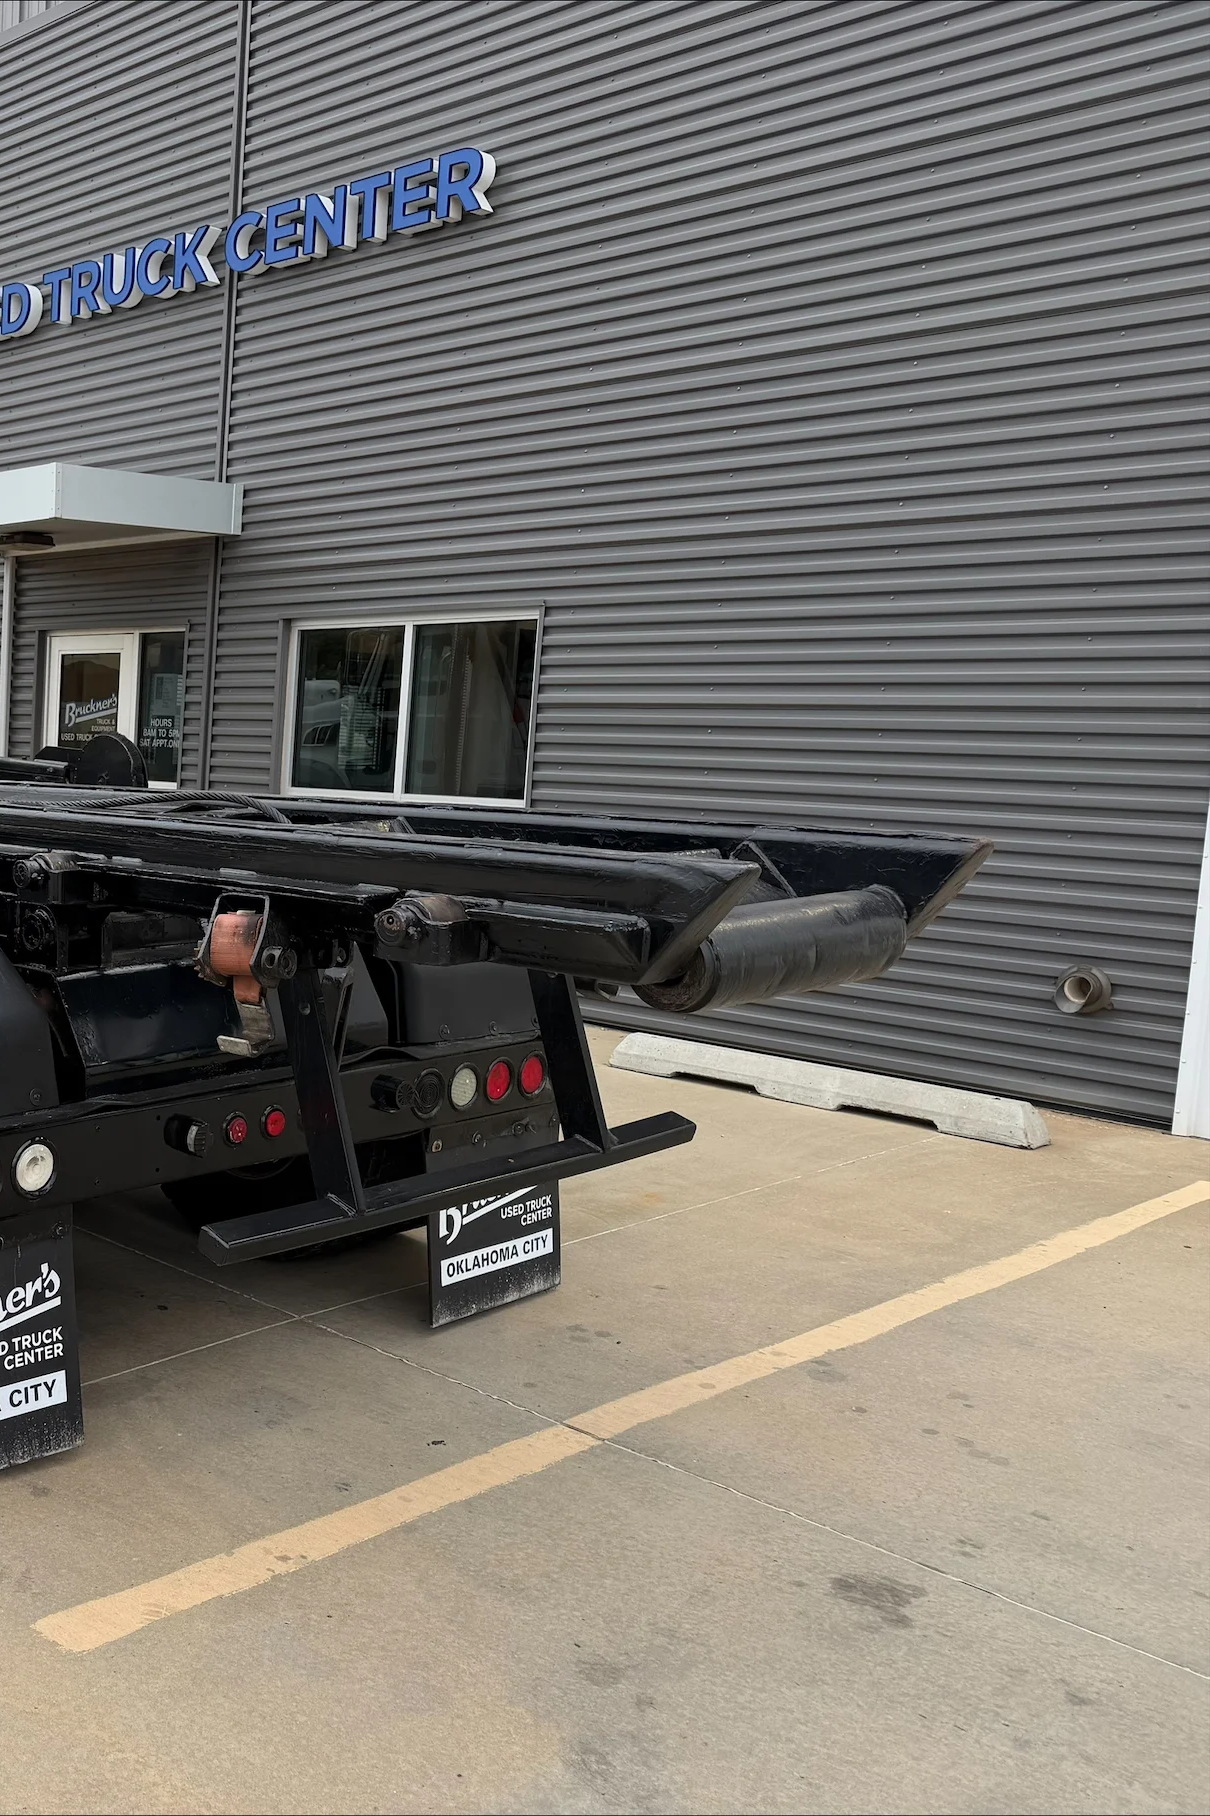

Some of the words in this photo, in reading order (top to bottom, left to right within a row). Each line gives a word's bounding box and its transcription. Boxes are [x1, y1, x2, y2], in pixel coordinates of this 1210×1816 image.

[43, 225, 218, 323] TRUCK
[224, 147, 492, 275] CENTER
[65, 693, 117, 727] Bruckner's
[150, 718, 172, 727] HOURS
[60, 733, 75, 741] USED
[139, 738, 151, 747] SAT
[142, 728, 157, 737] 8AM
[158, 729, 167, 738] TO
[500, 1203, 524, 1219] USED
[525, 1194, 552, 1213] TRUCK
[520, 1207, 552, 1226] CENTER
[446, 1244, 519, 1278] OKLAHOMA
[522, 1234, 548, 1255] CITY
[12, 1326, 63, 1352] TRUCK
[3, 1342, 64, 1371] CENTER
[8, 1378, 57, 1408] CITY
